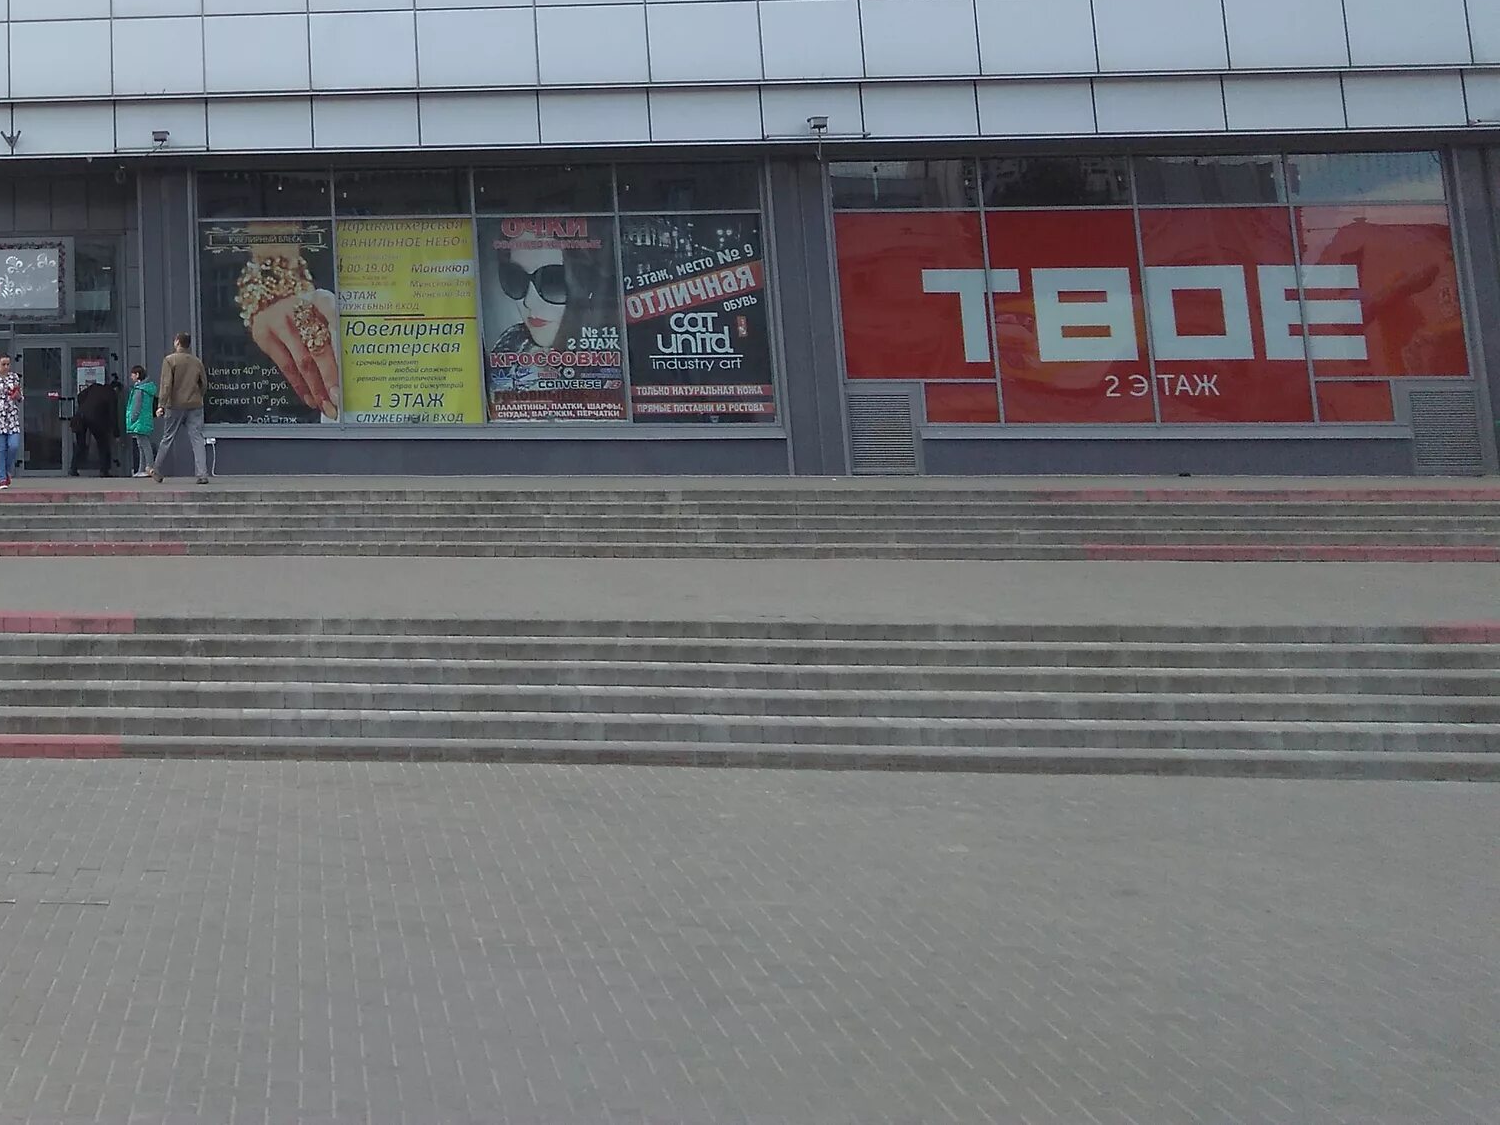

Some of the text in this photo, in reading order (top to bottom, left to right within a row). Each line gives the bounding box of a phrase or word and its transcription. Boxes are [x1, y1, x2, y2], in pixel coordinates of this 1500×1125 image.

[501, 218, 588, 238] ОЧКИ
[411, 263, 470, 274] Маникюр
[624, 276, 634, 291] 2
[717, 248, 741, 265] №
[744, 243, 754, 257] 9
[345, 291, 377, 300] ЭТАЖ
[723, 295, 758, 312] ОБУВЬ
[922, 264, 1368, 363] ТВОЕ
[346, 321, 465, 340] Ювелирная
[581, 326, 619, 338] № 11
[352, 342, 461, 356] мастерская
[567, 338, 620, 350] 2 ЭТАЖ
[356, 359, 419, 367] срочный ремонт
[489, 351, 621, 368] КРОССОВКИ
[652, 358, 742, 371] industry art
[208, 367, 231, 377] Цепи
[261, 368, 280, 378] руб.
[208, 382, 239, 391] Кольца
[270, 382, 289, 393] руб.
[538, 379, 602, 389] CONVERSE
[1105, 374, 1220, 398] 2 ЭТАЖ
[672, 386, 735, 395] НАТУРАЛЬНАЯ
[208, 397, 239, 407] Серьги
[270, 397, 289, 407] руб.
[373, 393, 445, 408] 1 ЭТАЖ
[637, 403, 764, 413] ПРЯМЫЕ ПОСТАВКИ ИЗ РОСТОВА
[433, 412, 464, 423] ВХОД
